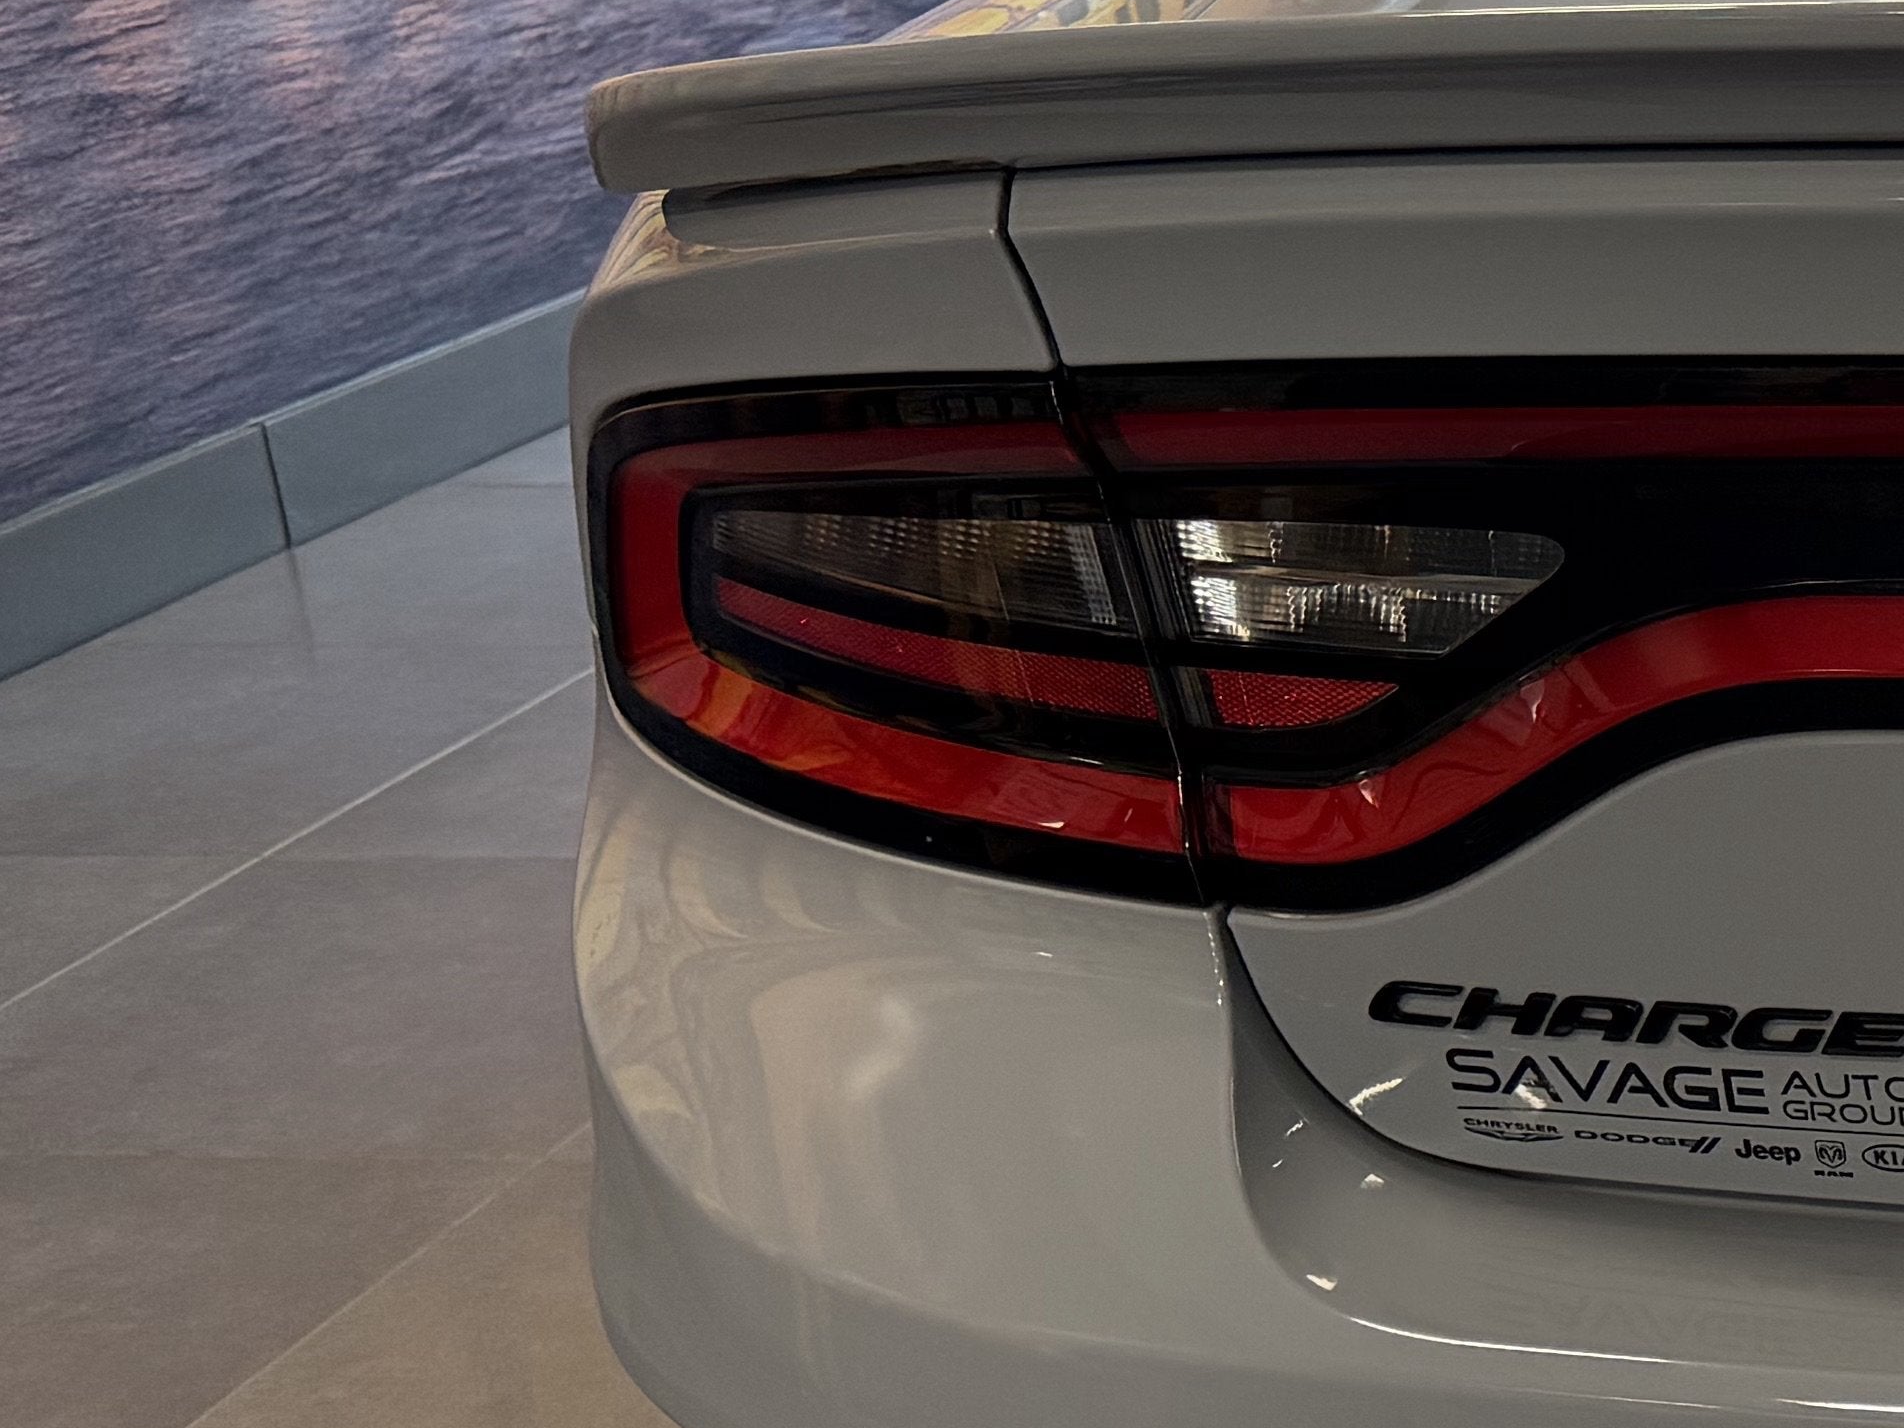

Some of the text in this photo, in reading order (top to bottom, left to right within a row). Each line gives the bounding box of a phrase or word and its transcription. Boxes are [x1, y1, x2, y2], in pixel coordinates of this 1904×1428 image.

[1445, 1048, 1770, 1115] SAVAGE
[1463, 1117, 1558, 1133] CHRYSLER
[1574, 1130, 1701, 1148] DODGE
[1735, 1139, 1801, 1165] Jeep
